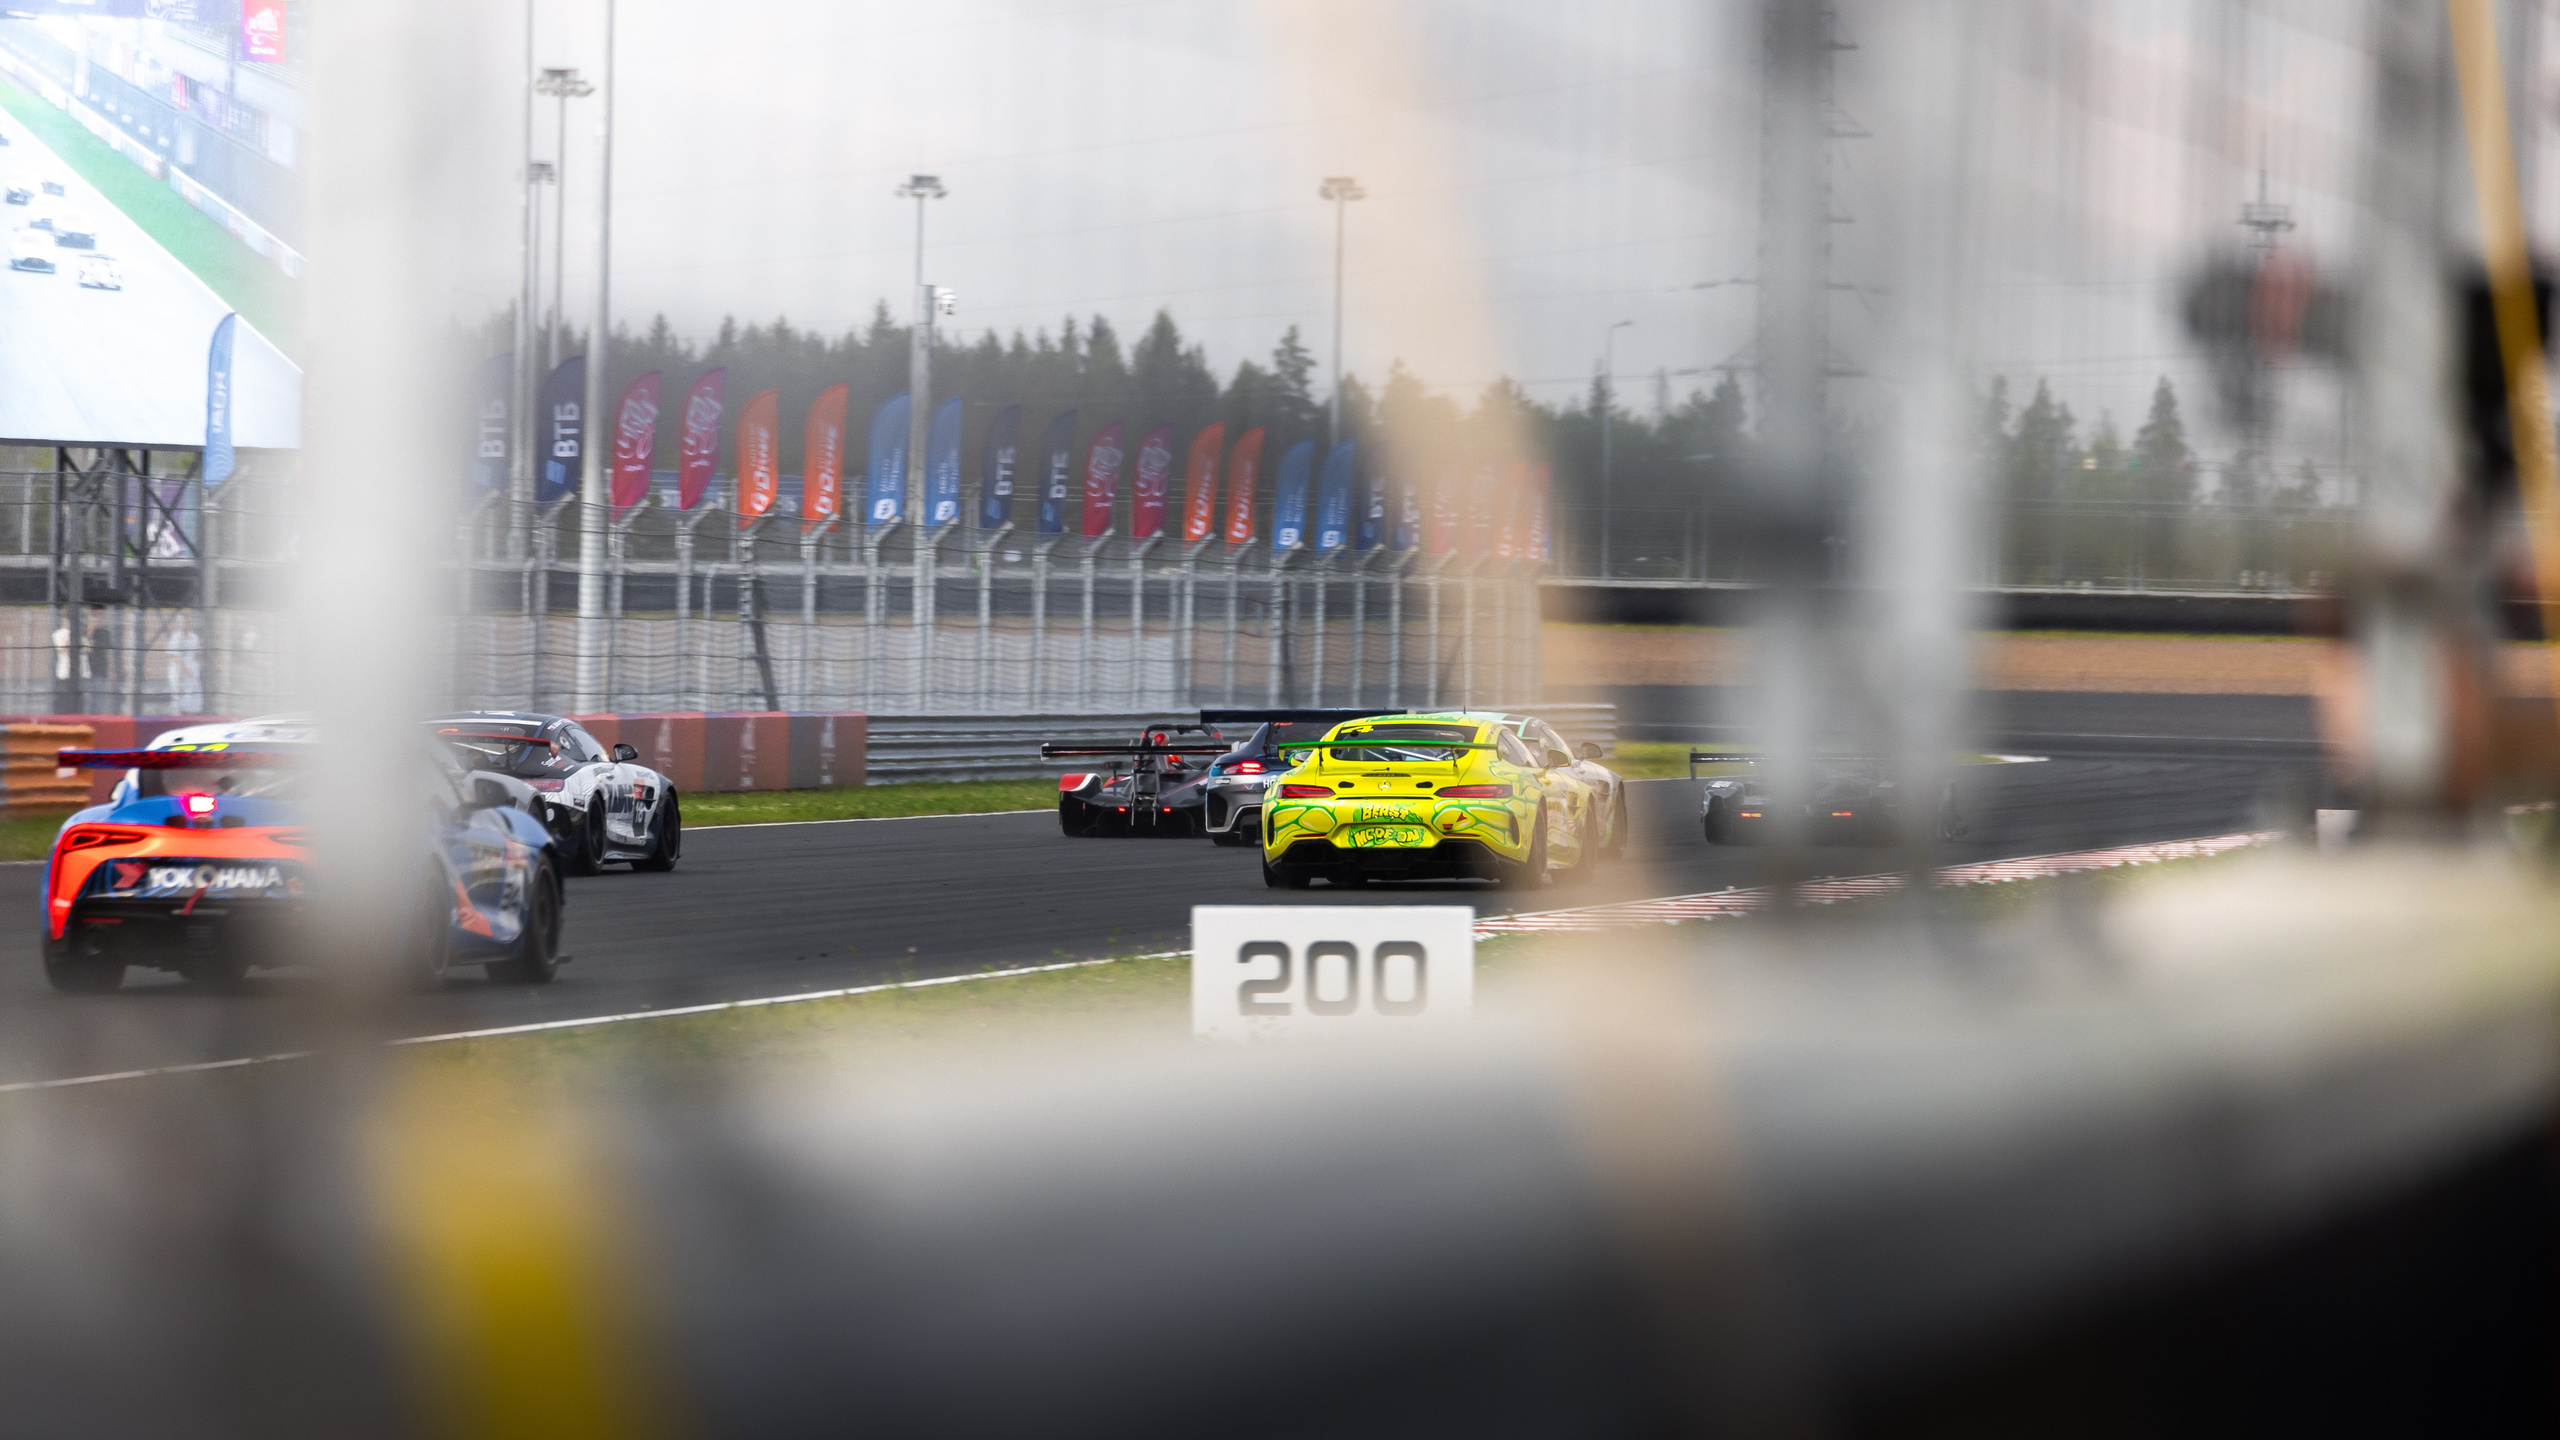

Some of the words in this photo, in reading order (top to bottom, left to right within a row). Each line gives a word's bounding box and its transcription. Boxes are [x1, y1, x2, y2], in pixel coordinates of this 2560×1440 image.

[478, 400, 507, 458] ВТБ
[552, 402, 581, 458] ВТБ
[994, 446, 1016, 496] ВТБ
[1354, 827, 1395, 848] MODE
[1396, 829, 1420, 843] ON
[1362, 805, 1410, 820] BEAST
[148, 864, 284, 889] YOKOHAMA
[1238, 940, 1428, 1016] 200
